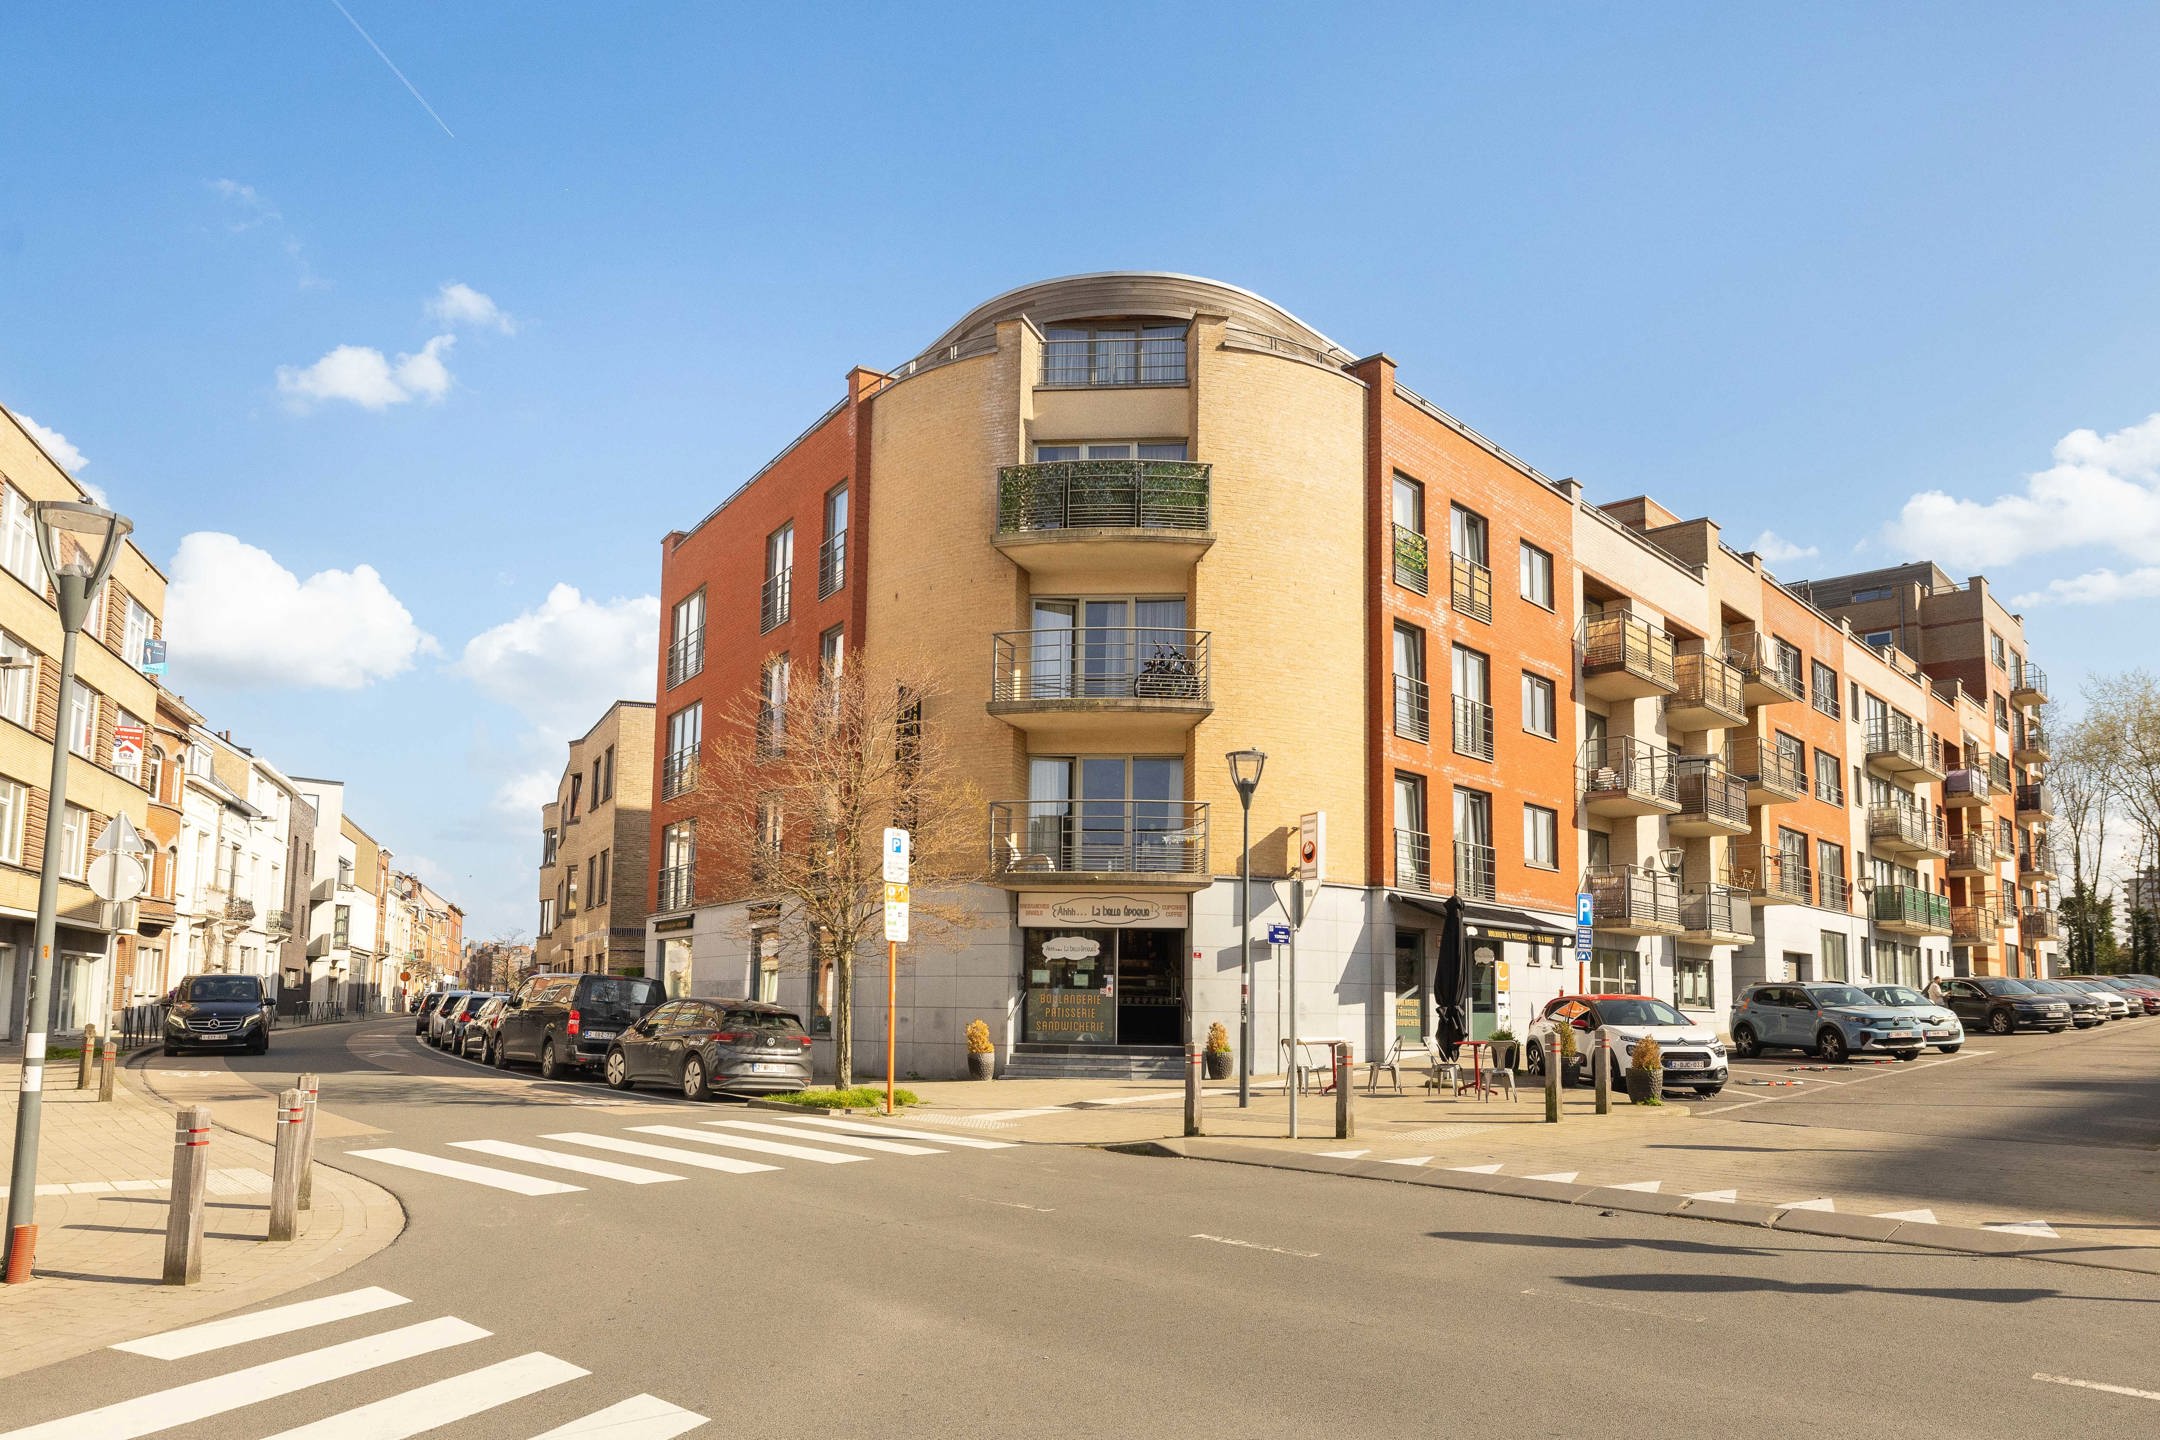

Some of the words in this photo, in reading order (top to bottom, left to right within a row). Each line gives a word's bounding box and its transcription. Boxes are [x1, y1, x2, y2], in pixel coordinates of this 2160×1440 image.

[1092, 905, 1100, 916] La
[1580, 899, 1590, 921] P
[1040, 993, 1101, 1004] BOULANGERIE
[1036, 1020, 1104, 1032] SANDWICHERIE
